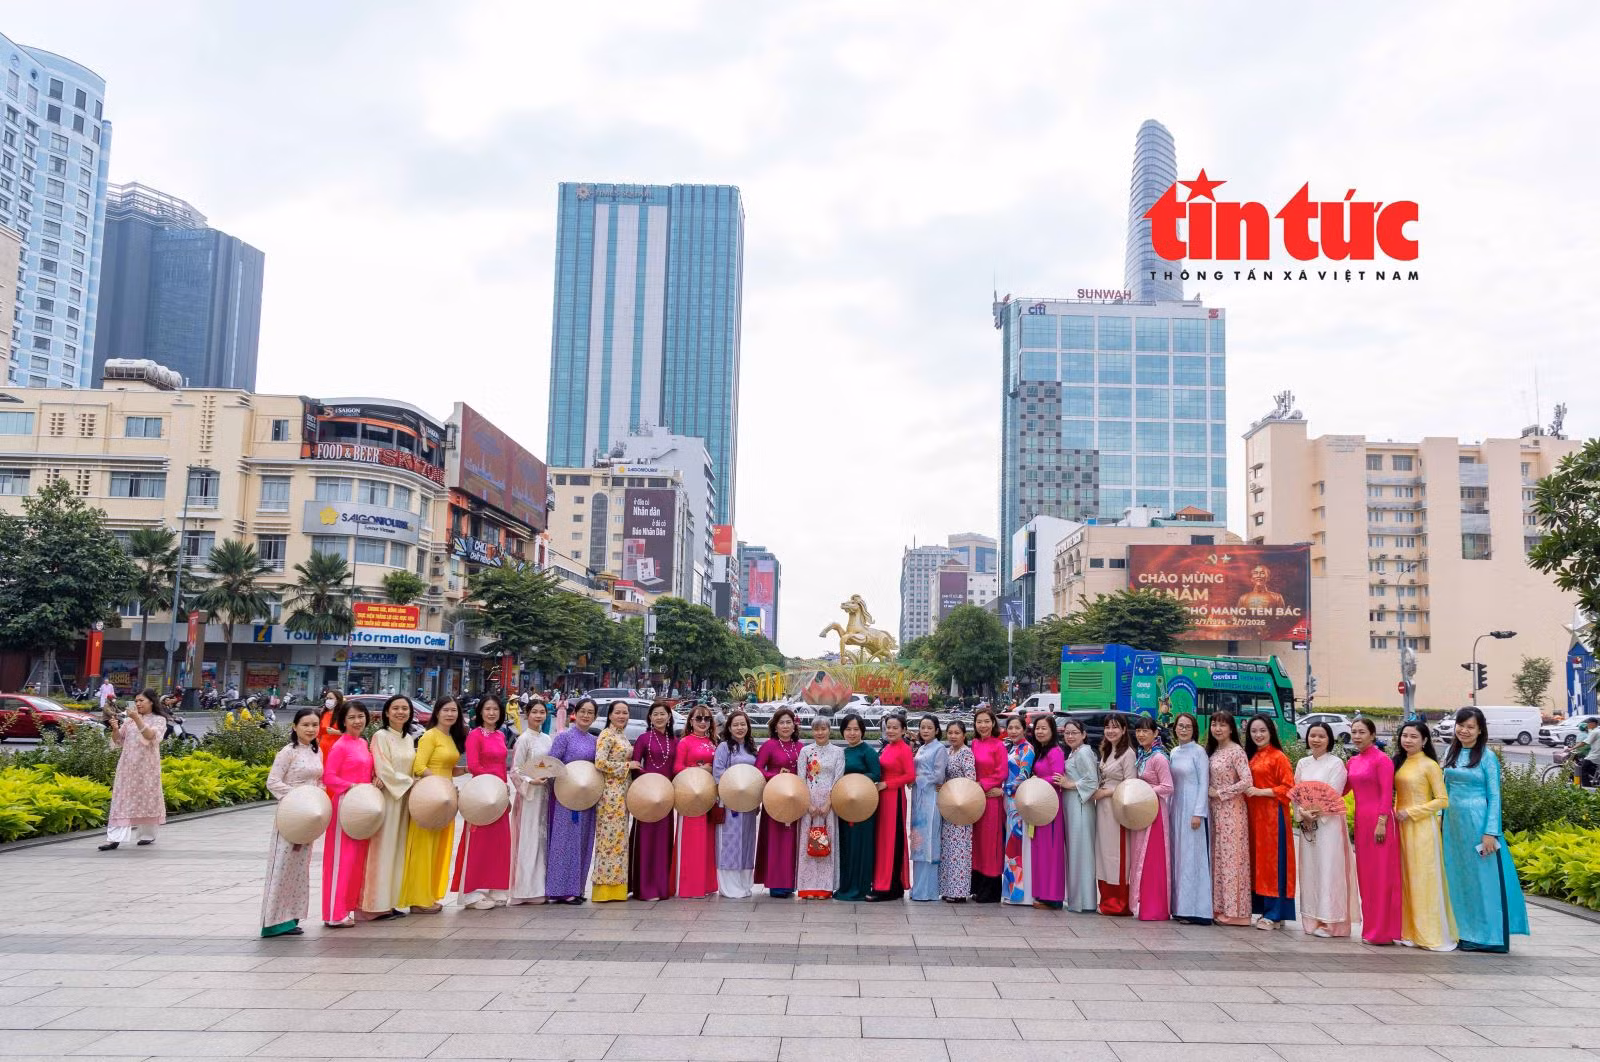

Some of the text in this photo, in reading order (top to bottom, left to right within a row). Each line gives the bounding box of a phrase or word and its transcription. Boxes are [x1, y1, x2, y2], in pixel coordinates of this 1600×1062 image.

[1077, 289, 1132, 300] SUNWAH
[1028, 303, 1046, 315] citi
[317, 443, 380, 463] FOOD & BEER
[633, 506, 661, 517] Nhân dân
[642, 527, 656, 536] Nhân
[1138, 570, 1224, 583] CHÀO MỪNG
[1166, 584, 1209, 601] NĂM
[1211, 607, 1247, 616] MANG
[1276, 605, 1301, 616] BÁC
[284, 629, 338, 641] Tourst
